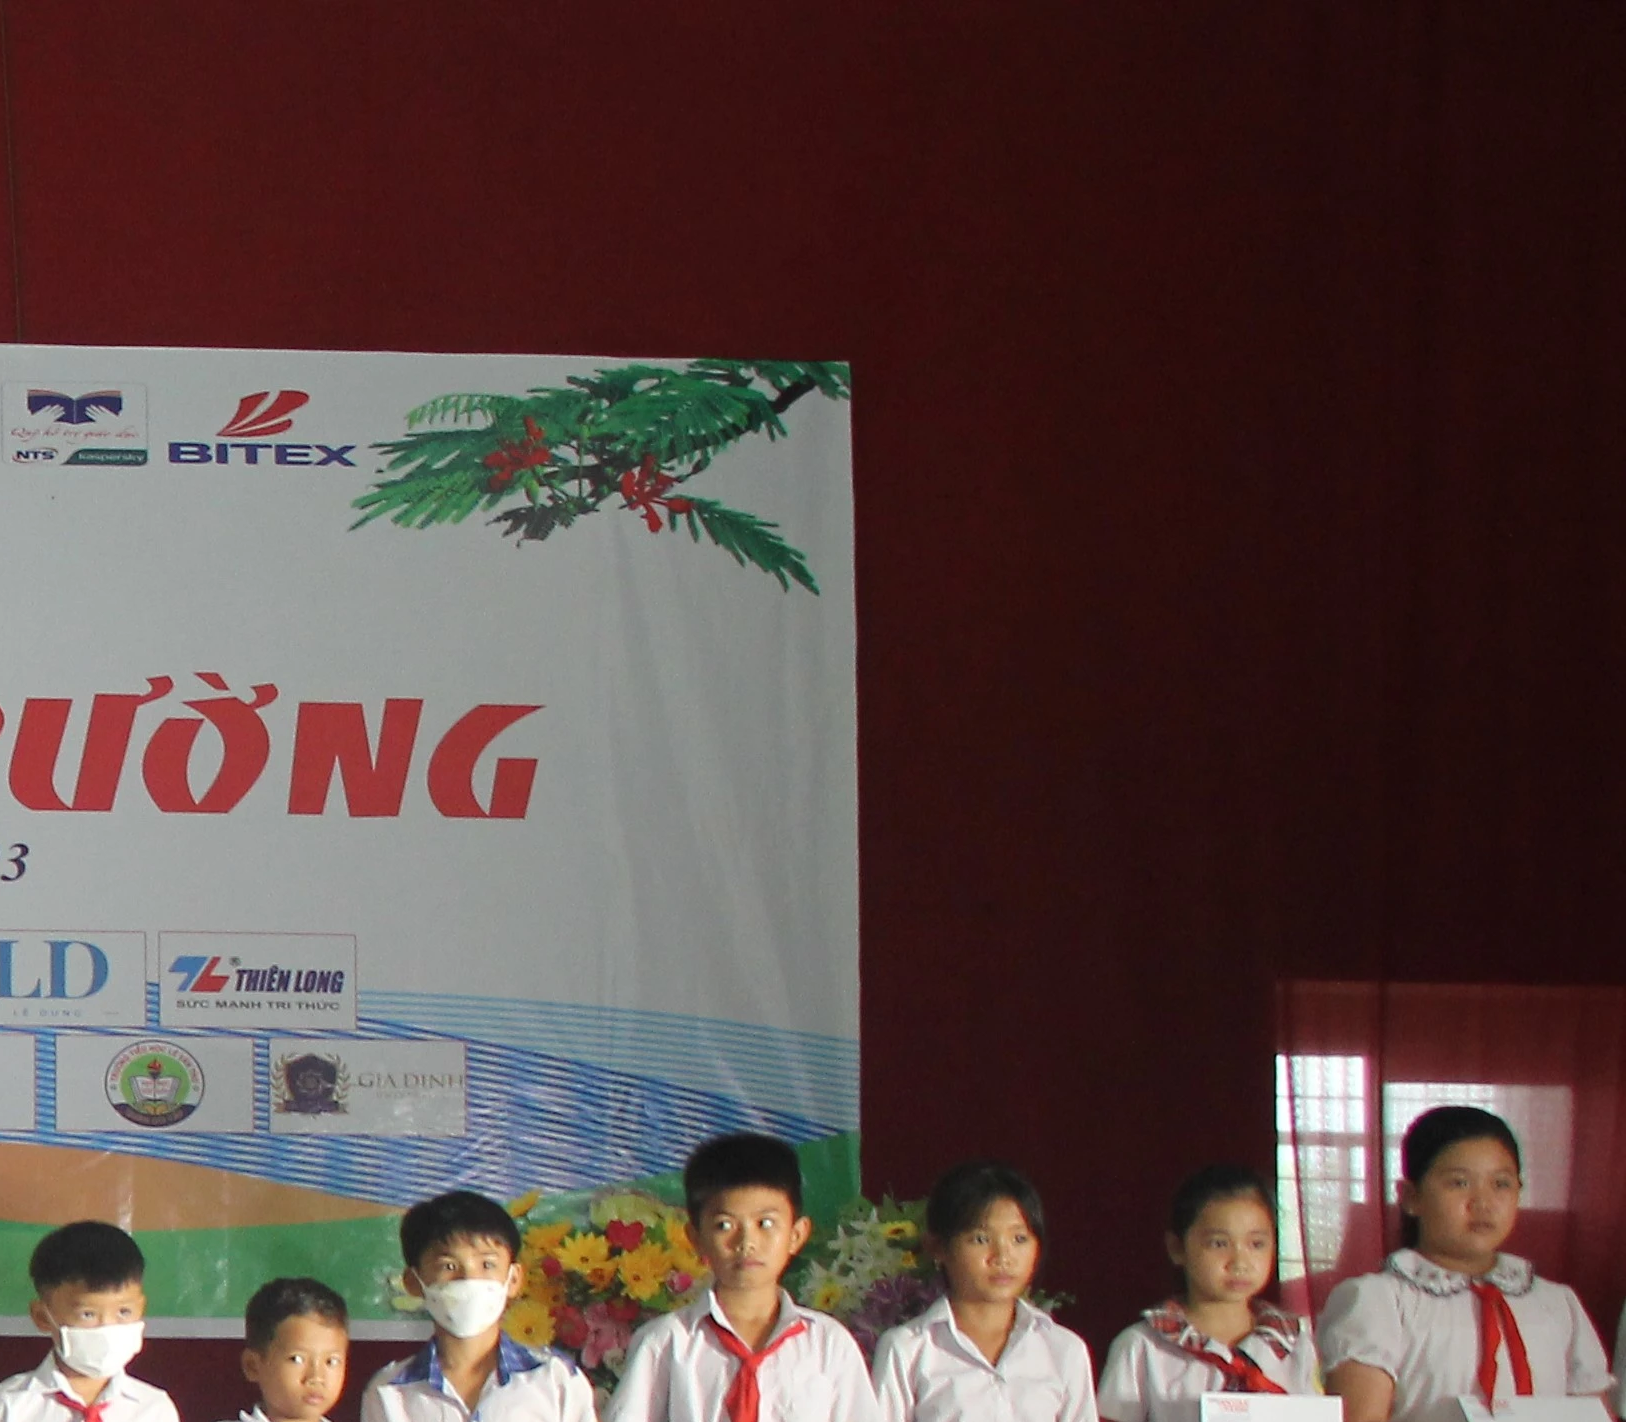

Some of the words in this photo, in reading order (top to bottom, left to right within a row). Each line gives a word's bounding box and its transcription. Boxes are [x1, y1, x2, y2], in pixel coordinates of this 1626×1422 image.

[16, 450, 55, 460] NTS
[78, 453, 144, 462] kaspersky
[168, 442, 357, 466] BITEX
[235, 964, 292, 993] THIÊN
[294, 970, 345, 994] LONG
[357, 1072, 396, 1088] GIA
